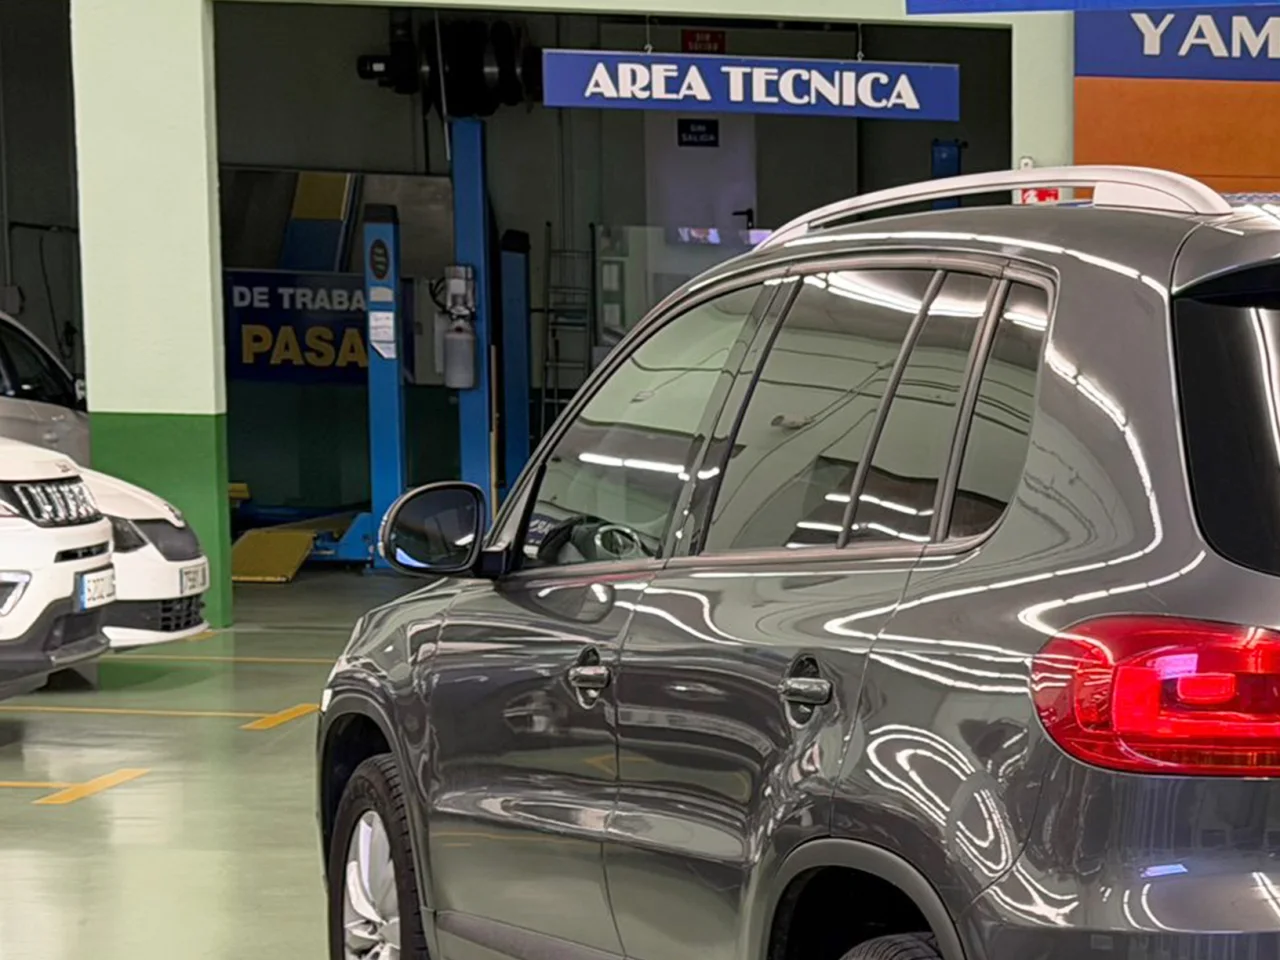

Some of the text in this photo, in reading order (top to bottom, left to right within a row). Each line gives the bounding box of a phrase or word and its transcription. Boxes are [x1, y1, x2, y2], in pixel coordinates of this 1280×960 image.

[584, 61, 921, 111] AREA TECNICA
[232, 285, 271, 309] DE
